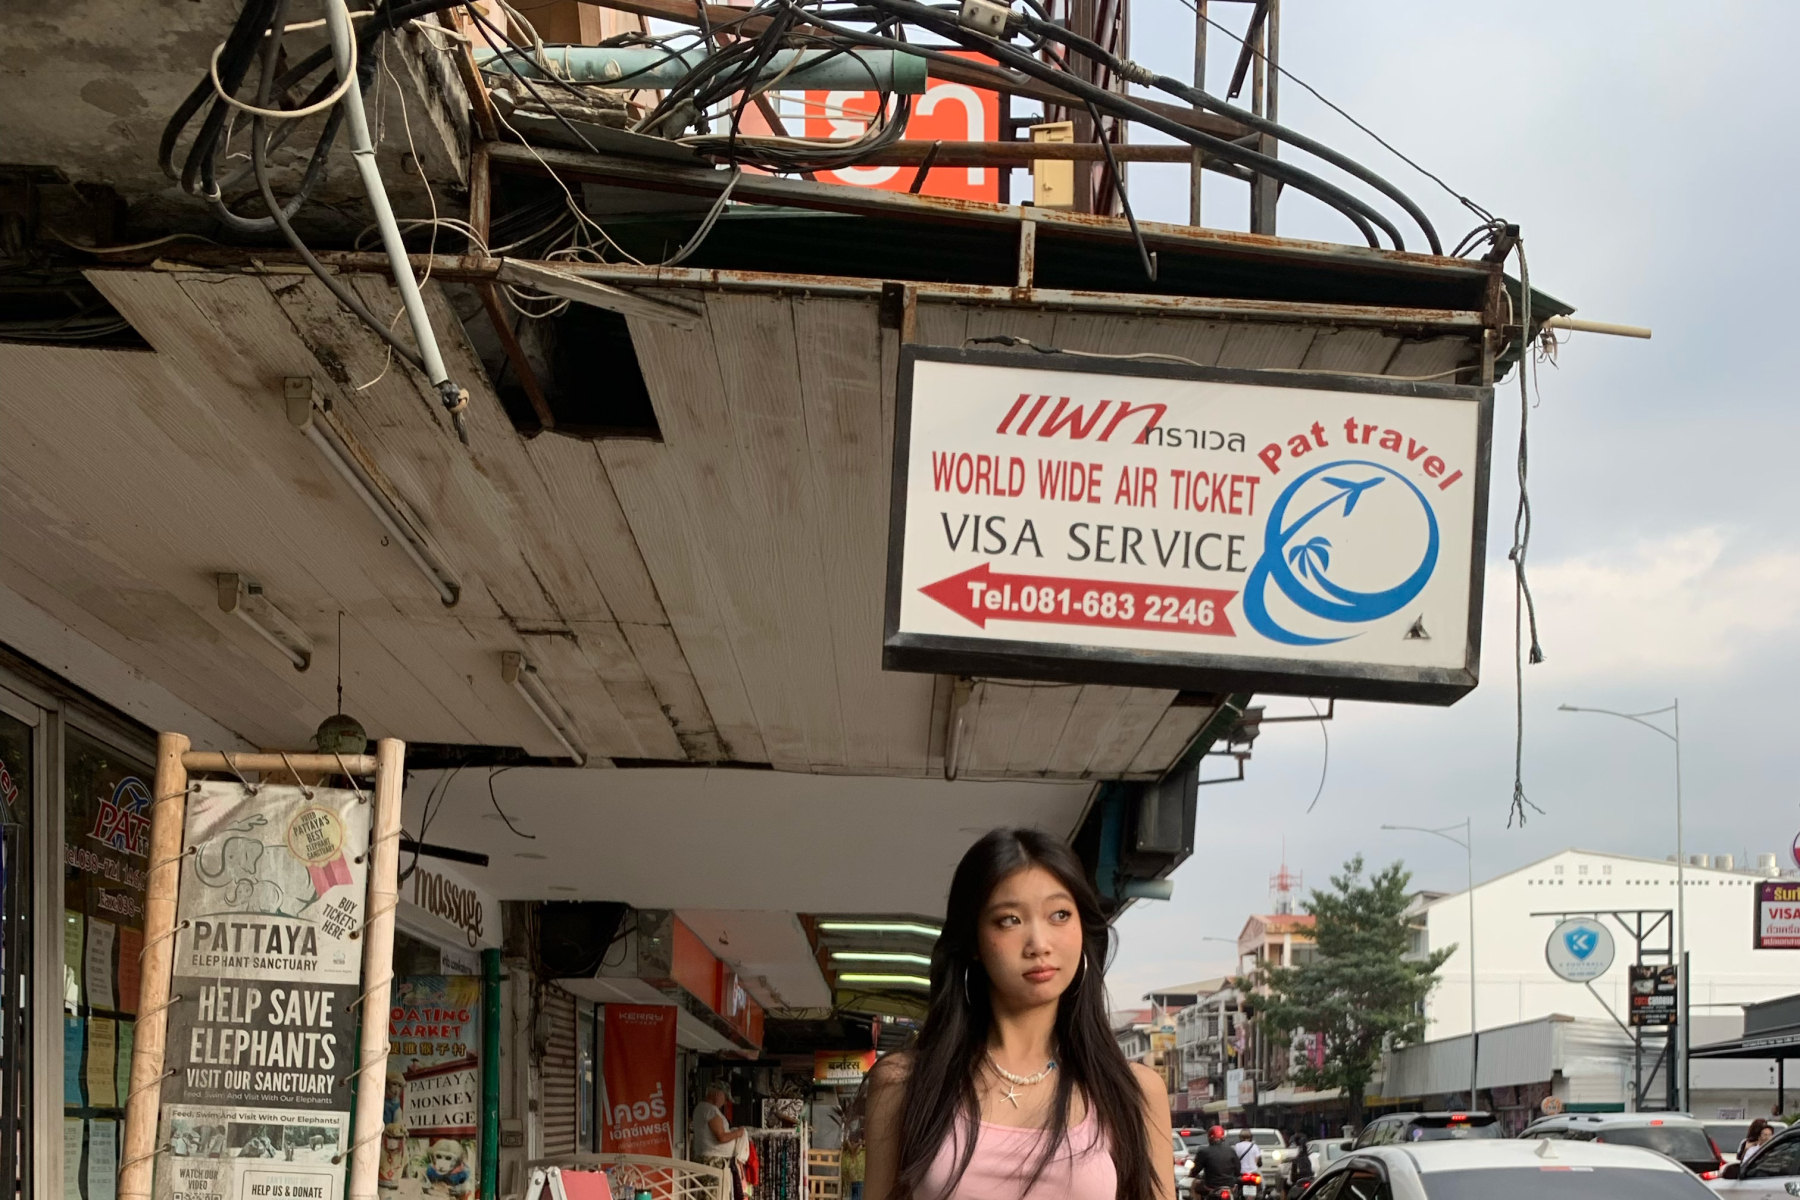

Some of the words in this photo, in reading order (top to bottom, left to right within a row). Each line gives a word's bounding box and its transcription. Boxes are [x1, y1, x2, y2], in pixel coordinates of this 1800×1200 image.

[996, 393, 1168, 445] แพท
[1145, 425, 1246, 453] ทราเวล
[1257, 420, 1329, 475] Pat
[1343, 416, 1464, 491] travel
[932, 451, 1025, 497] WORLD
[1038, 458, 1102, 504] WIDE
[1114, 465, 1157, 508] AIR
[1170, 468, 1260, 516] TICKET
[940, 512, 1043, 557] VISA
[1067, 522, 1248, 572] SERVICE
[967, 581, 1135, 620] Tel.081-683
[1144, 595, 1214, 627] 2246
[293, 814, 330, 837] PATTAYA'S
[306, 828, 324, 843] BEST
[338, 896, 358, 914] BUY
[414, 865, 483, 948] massage
[1769, 907, 1800, 920] VISA
[322, 903, 357, 931] TICKETS
[193, 921, 318, 956] PATTAYA
[321, 919, 346, 941] HERE
[191, 954, 250, 968] ELEPHANT
[252, 956, 318, 972] SANCTUARY
[198, 985, 262, 1023] HELP
[268, 988, 335, 1027] SAVE
[390, 1007, 471, 1024] OATING
[618, 1012, 664, 1021] KERRY
[189, 1027, 337, 1070] ELEPHANTS
[389, 1041, 467, 1057] 提雅猴子村
[186, 1068, 221, 1089] VISIT
[224, 1070, 250, 1090] OUR
[254, 1071, 335, 1094] SANCTUARY
[410, 1071, 476, 1093] PATTAYA
[227, 1092, 242, 1100] And
[244, 1093, 259, 1101] Visit
[261, 1094, 279, 1102] With
[280, 1095, 294, 1103] Our
[296, 1096, 332, 1106] Elephants
[410, 1090, 476, 1110] MONKEY
[196, 1111, 218, 1119] Swim
[220, 1112, 237, 1120] And
[238, 1112, 257, 1121] Visit
[258, 1114, 278, 1122] With
[280, 1115, 295, 1123] Our
[297, 1116, 340, 1125] Elephants!
[409, 1111, 476, 1127] VILLAGE
[179, 1168, 203, 1180] WATCH
[204, 1170, 218, 1180] OUR
[188, 1180, 208, 1190] VIDEO
[251, 1184, 271, 1196] HELP
[272, 1185, 283, 1197] US
[284, 1185, 291, 1197] &
[292, 1186, 323, 1199] DONATE
